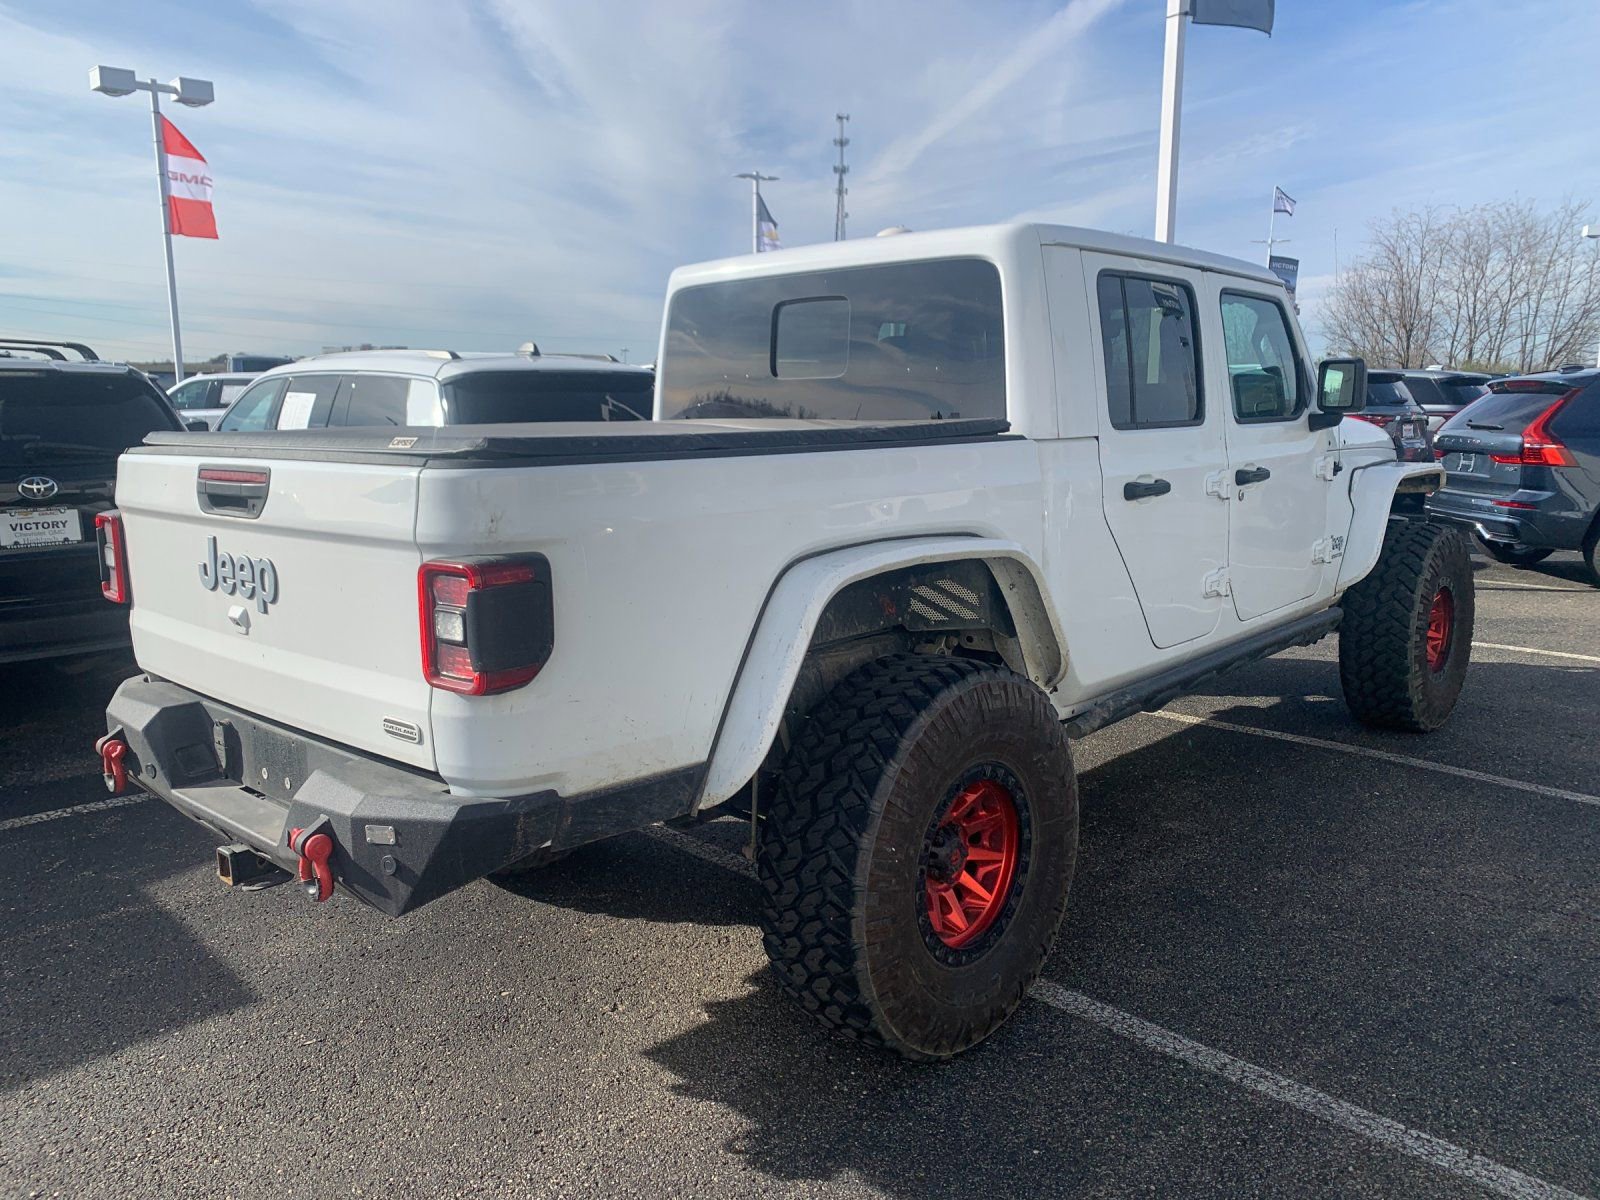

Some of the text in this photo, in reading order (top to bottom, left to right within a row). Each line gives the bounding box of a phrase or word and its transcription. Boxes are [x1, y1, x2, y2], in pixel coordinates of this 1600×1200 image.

[168, 170, 212, 188] GMC
[1272, 261, 1298, 272] VICTORY
[9, 520, 68, 532] VICTORY
[198, 534, 279, 615] Jeep
